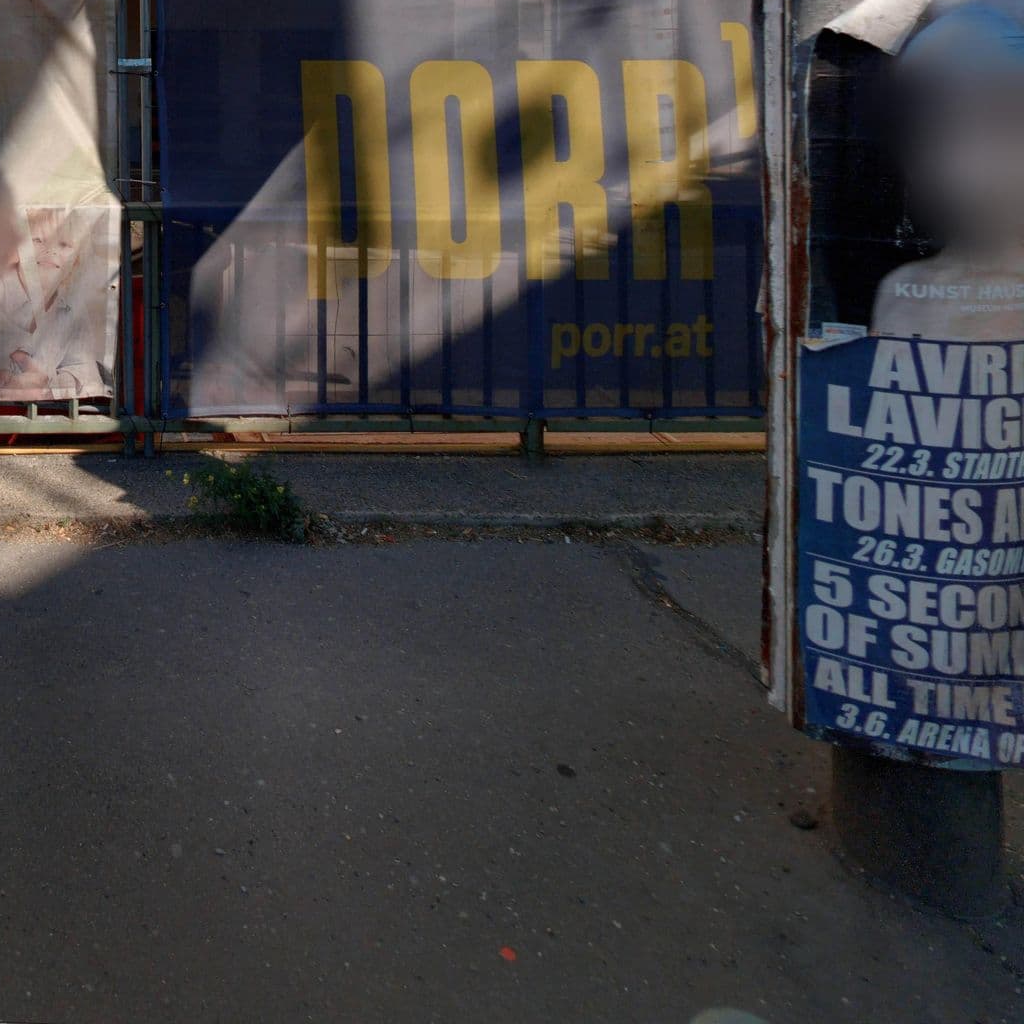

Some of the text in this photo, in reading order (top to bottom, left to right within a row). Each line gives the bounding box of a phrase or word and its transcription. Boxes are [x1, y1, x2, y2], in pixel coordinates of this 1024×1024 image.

[300, 60, 714, 300] PORR
[894, 282, 971, 300] KUNST
[551, 314, 714, 369] porr.at
[861, 443, 935, 477] 22.3.
[807, 466, 984, 545] TONES
[852, 536, 1024, 576] 26.3. GASOM
[813, 560, 854, 608] 5
[805, 604, 878, 658] OF
[813, 656, 1017, 726] ALL TIME
[835, 703, 890, 740] 3.6.
[896, 718, 991, 760] ARENA
